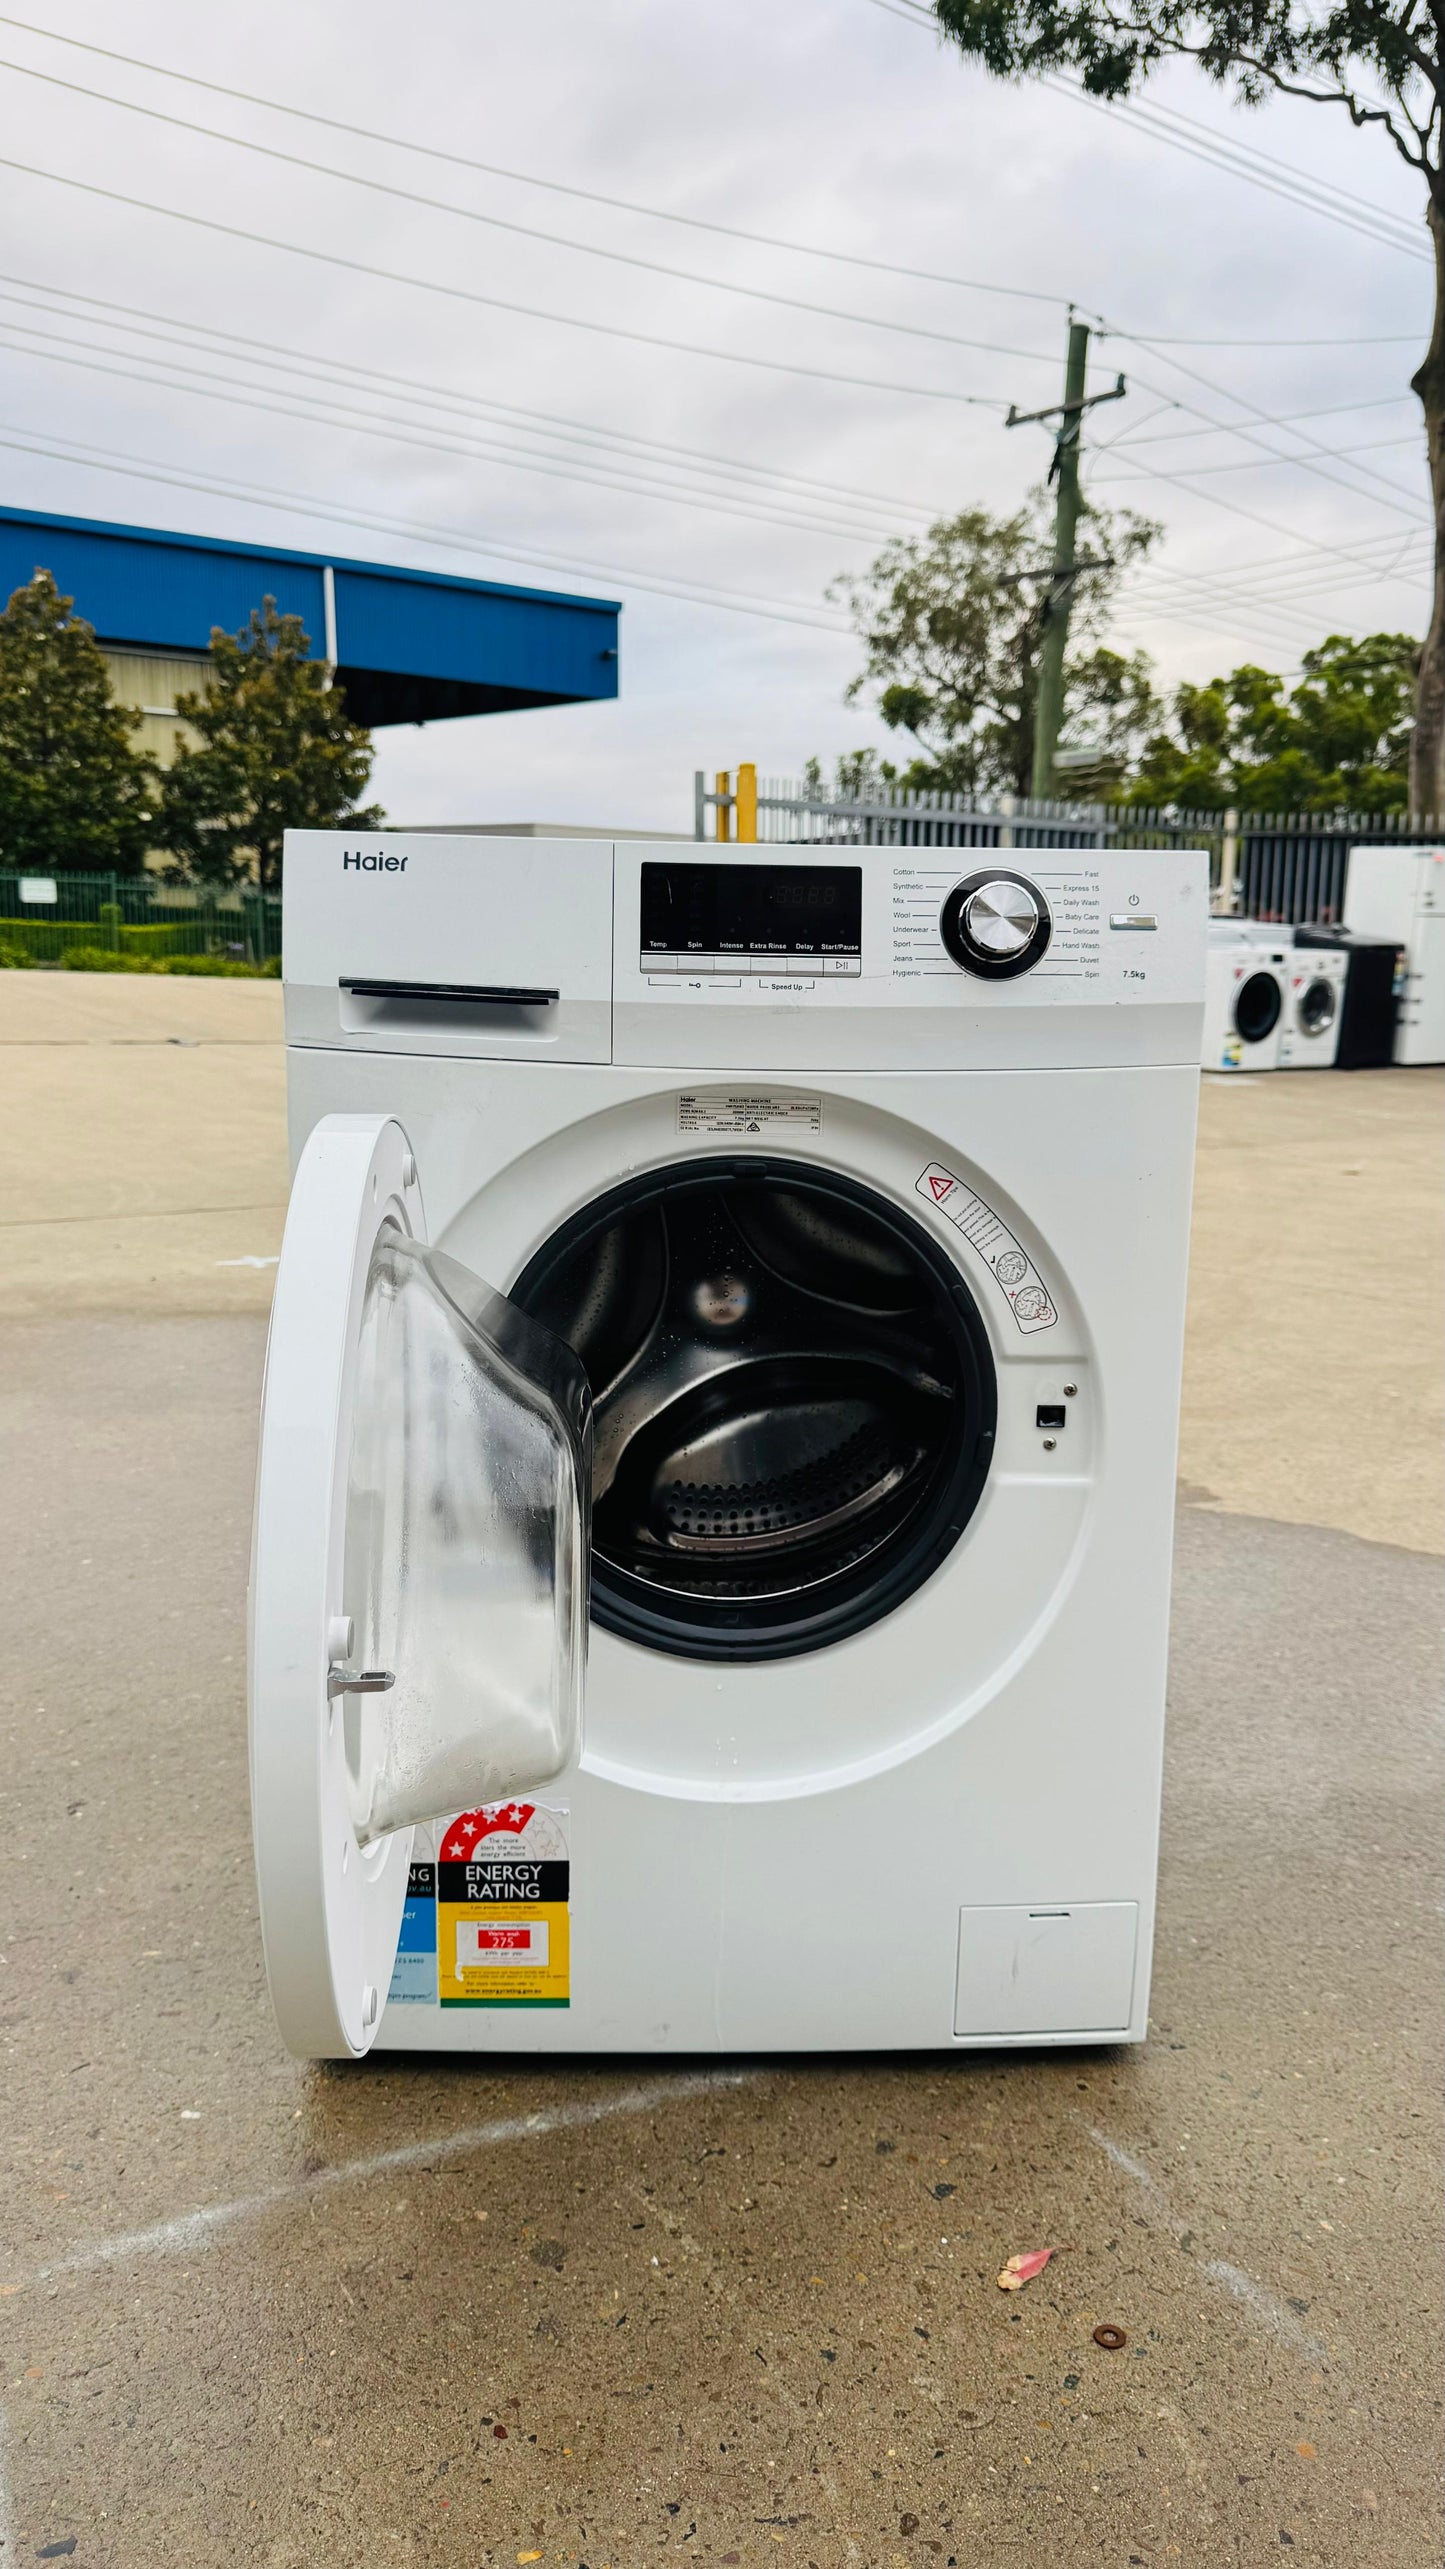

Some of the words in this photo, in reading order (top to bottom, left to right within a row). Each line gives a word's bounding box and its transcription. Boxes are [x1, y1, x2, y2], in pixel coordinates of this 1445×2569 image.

[344, 851, 408, 872] Haier
[893, 868, 915, 876] Cotton
[1084, 870, 1100, 878] Fast
[893, 882, 924, 891] Synthetic
[1063, 885, 1089, 893] Express
[1063, 899, 1080, 907] Daily
[1065, 913, 1080, 922] Baby
[796, 943, 814, 951] Delay
[893, 940, 911, 949] Sport
[892, 969, 922, 978] Hygienic
[1084, 970, 1100, 979] Spin
[1122, 970, 1146, 980] 7.5kg
[466, 1865, 542, 1881] ENERGY
[467, 1883, 540, 1899] RATING
[493, 1937, 514, 1948] 275
